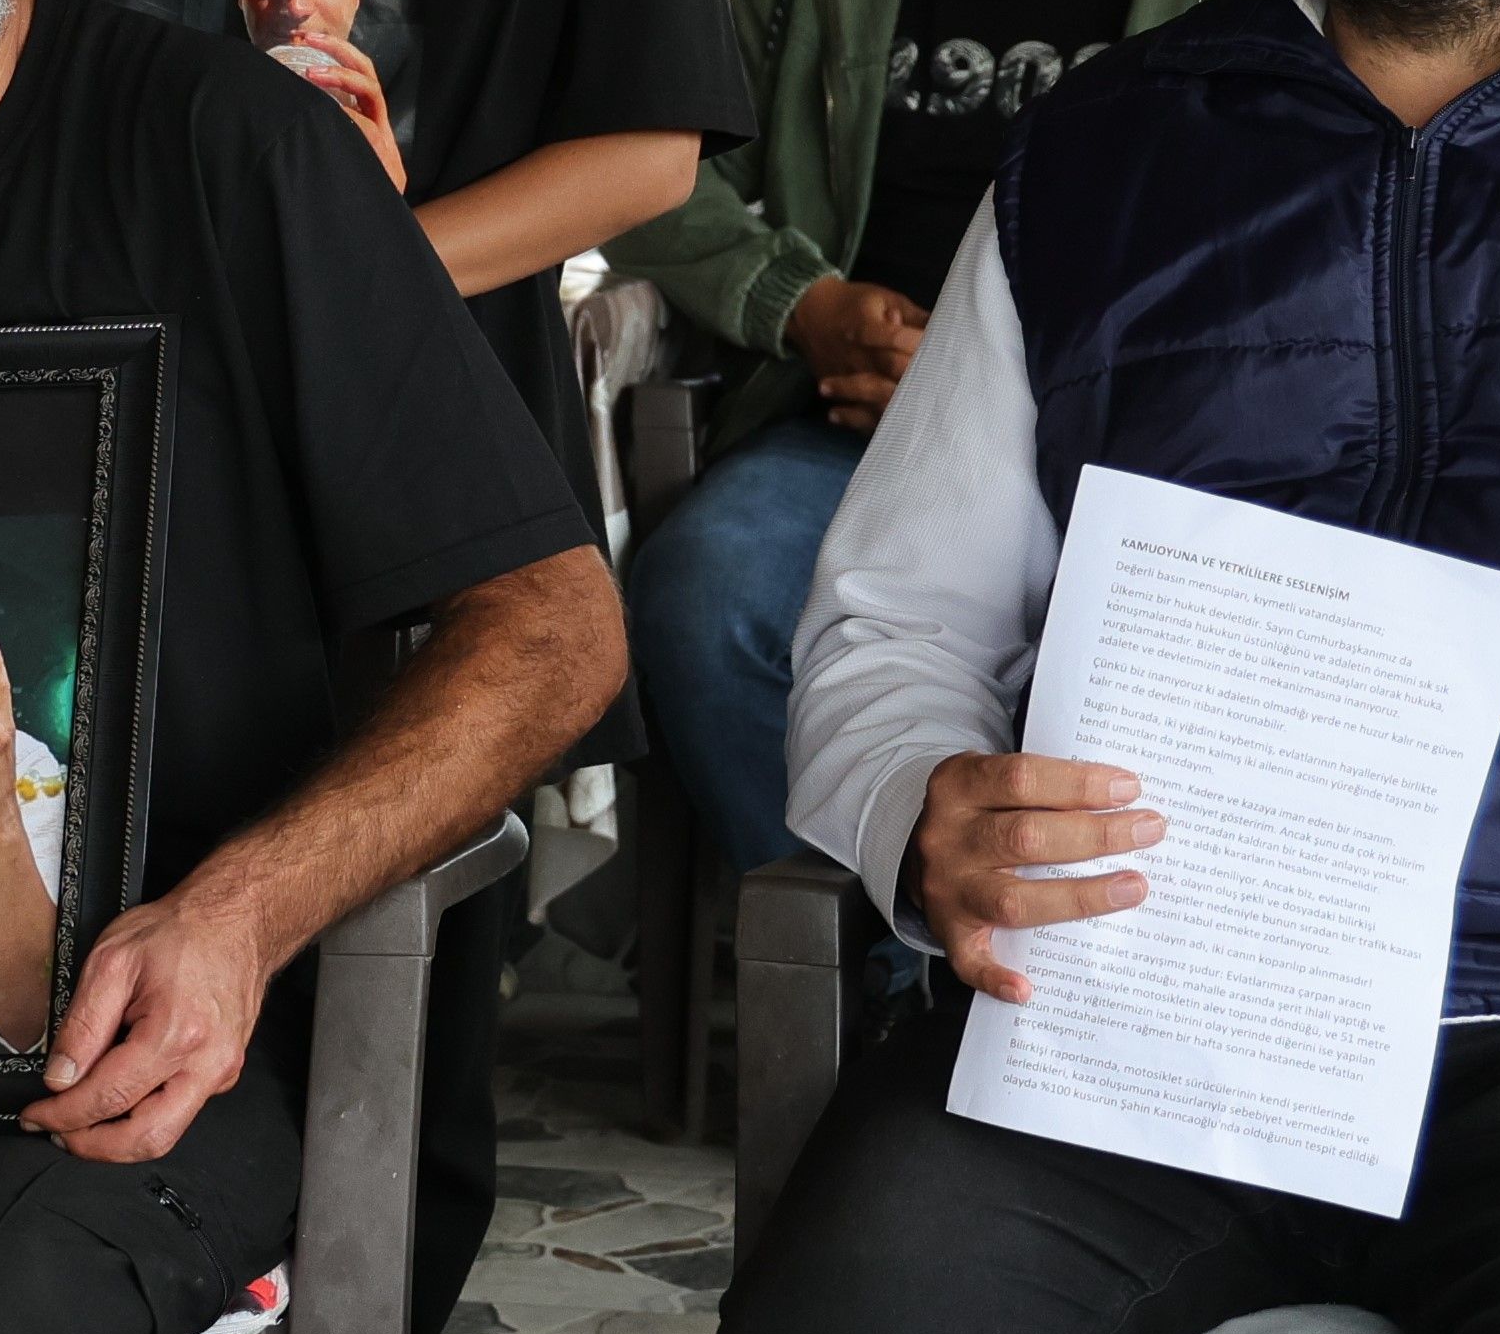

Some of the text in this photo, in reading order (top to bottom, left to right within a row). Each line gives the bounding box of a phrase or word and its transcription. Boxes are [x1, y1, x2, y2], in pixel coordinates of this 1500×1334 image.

[1115, 560, 1155, 578] Değerli
[1156, 569, 1186, 586] basın
[1252, 592, 1297, 614] kıymetli
[1120, 537, 1351, 602] KAMUOYUNA VE YETKİLİLERE SESLENİŞİM
[1097, 635, 1140, 652] adalete
[1141, 645, 1155, 656] ve
[1156, 647, 1222, 673] devletimizin
[1223, 666, 1258, 682] adalet
[1110, 581, 1154, 603] Ülkemiz
[1155, 593, 1172, 606] bir
[1173, 597, 1207, 616] hukuk
[1264, 620, 1294, 637] Sayın
[1398, 655, 1413, 668] da
[1194, 620, 1242, 642] hukukun
[1243, 634, 1311, 660] üstünlüğünü
[1312, 653, 1326, 664] ve
[1327, 656, 1372, 674] adaletin
[1372, 666, 1418, 686] önemini
[1088, 672, 1114, 688] kalır
[1114, 681, 1130, 693] ne
[1130, 684, 1146, 697] de
[1147, 687, 1191, 708] devletin
[1192, 698, 1225, 717] itibarı
[1196, 638, 1227, 655] Bizler
[1227, 647, 1243, 660] de
[1243, 650, 1259, 664] bu
[1260, 656, 1301, 675] ülkenin
[1302, 667, 1368, 692] vatandaşları
[1369, 684, 1403, 701] olarak
[1074, 730, 1103, 746] baba
[1104, 739, 1139, 756] olarak
[1092, 656, 1464, 760] Çünkü biz inanıyoruz ki adaletin olmadığı yerde ne huzur kalır ne güven
[1079, 713, 1440, 815] kendi umutları da yarım kalmış iki ailenin acısını yüreğinde taşıyan bir
[1083, 696, 1119, 714] Bugün
[1164, 716, 1178, 729] iki
[1178, 722, 1217, 739] yiğidini
[1278, 748, 1338, 770] evlatlarının
[1339, 761, 1400, 787] hayalleriyle
[1400, 777, 1438, 797] birlikte
[1025, 964, 1083, 985] çarpmanın
[1084, 977, 1130, 995] etkisiyle
[1131, 987, 1201, 1010] motosikletin
[1202, 1001, 1227, 1016] alev
[1228, 1007, 1268, 1025] topuna
[1324, 1029, 1338, 1041] ve
[1340, 1031, 1354, 1044] 51
[1356, 1037, 1391, 1053] metre
[1009, 1037, 1048, 1057] Bilirkişi
[1123, 1065, 1183, 1086] motosiklet
[1259, 1091, 1291, 1109] kendi
[1292, 1102, 1356, 1124] şeritlerinde
[1071, 1069, 1097, 1085] kaza
[1098, 1076, 1161, 1099] oluşumuna
[1162, 1089, 1227, 1113] kusurlarıyla
[1229, 1105, 1283, 1126] sebebiyet
[1285, 1118, 1354, 1142] vermedikleri
[1356, 1134, 1370, 1145] ve
[1002, 1073, 1038, 1090] olayda
[1040, 1080, 1072, 1097] %100
[1072, 1087, 1118, 1108] kusurun
[1119, 1098, 1151, 1115] Şahin
[1242, 1126, 1303, 1148] olduğunun
[1304, 1140, 1337, 1157] tespit
[1338, 1148, 1380, 1167] edildiği
